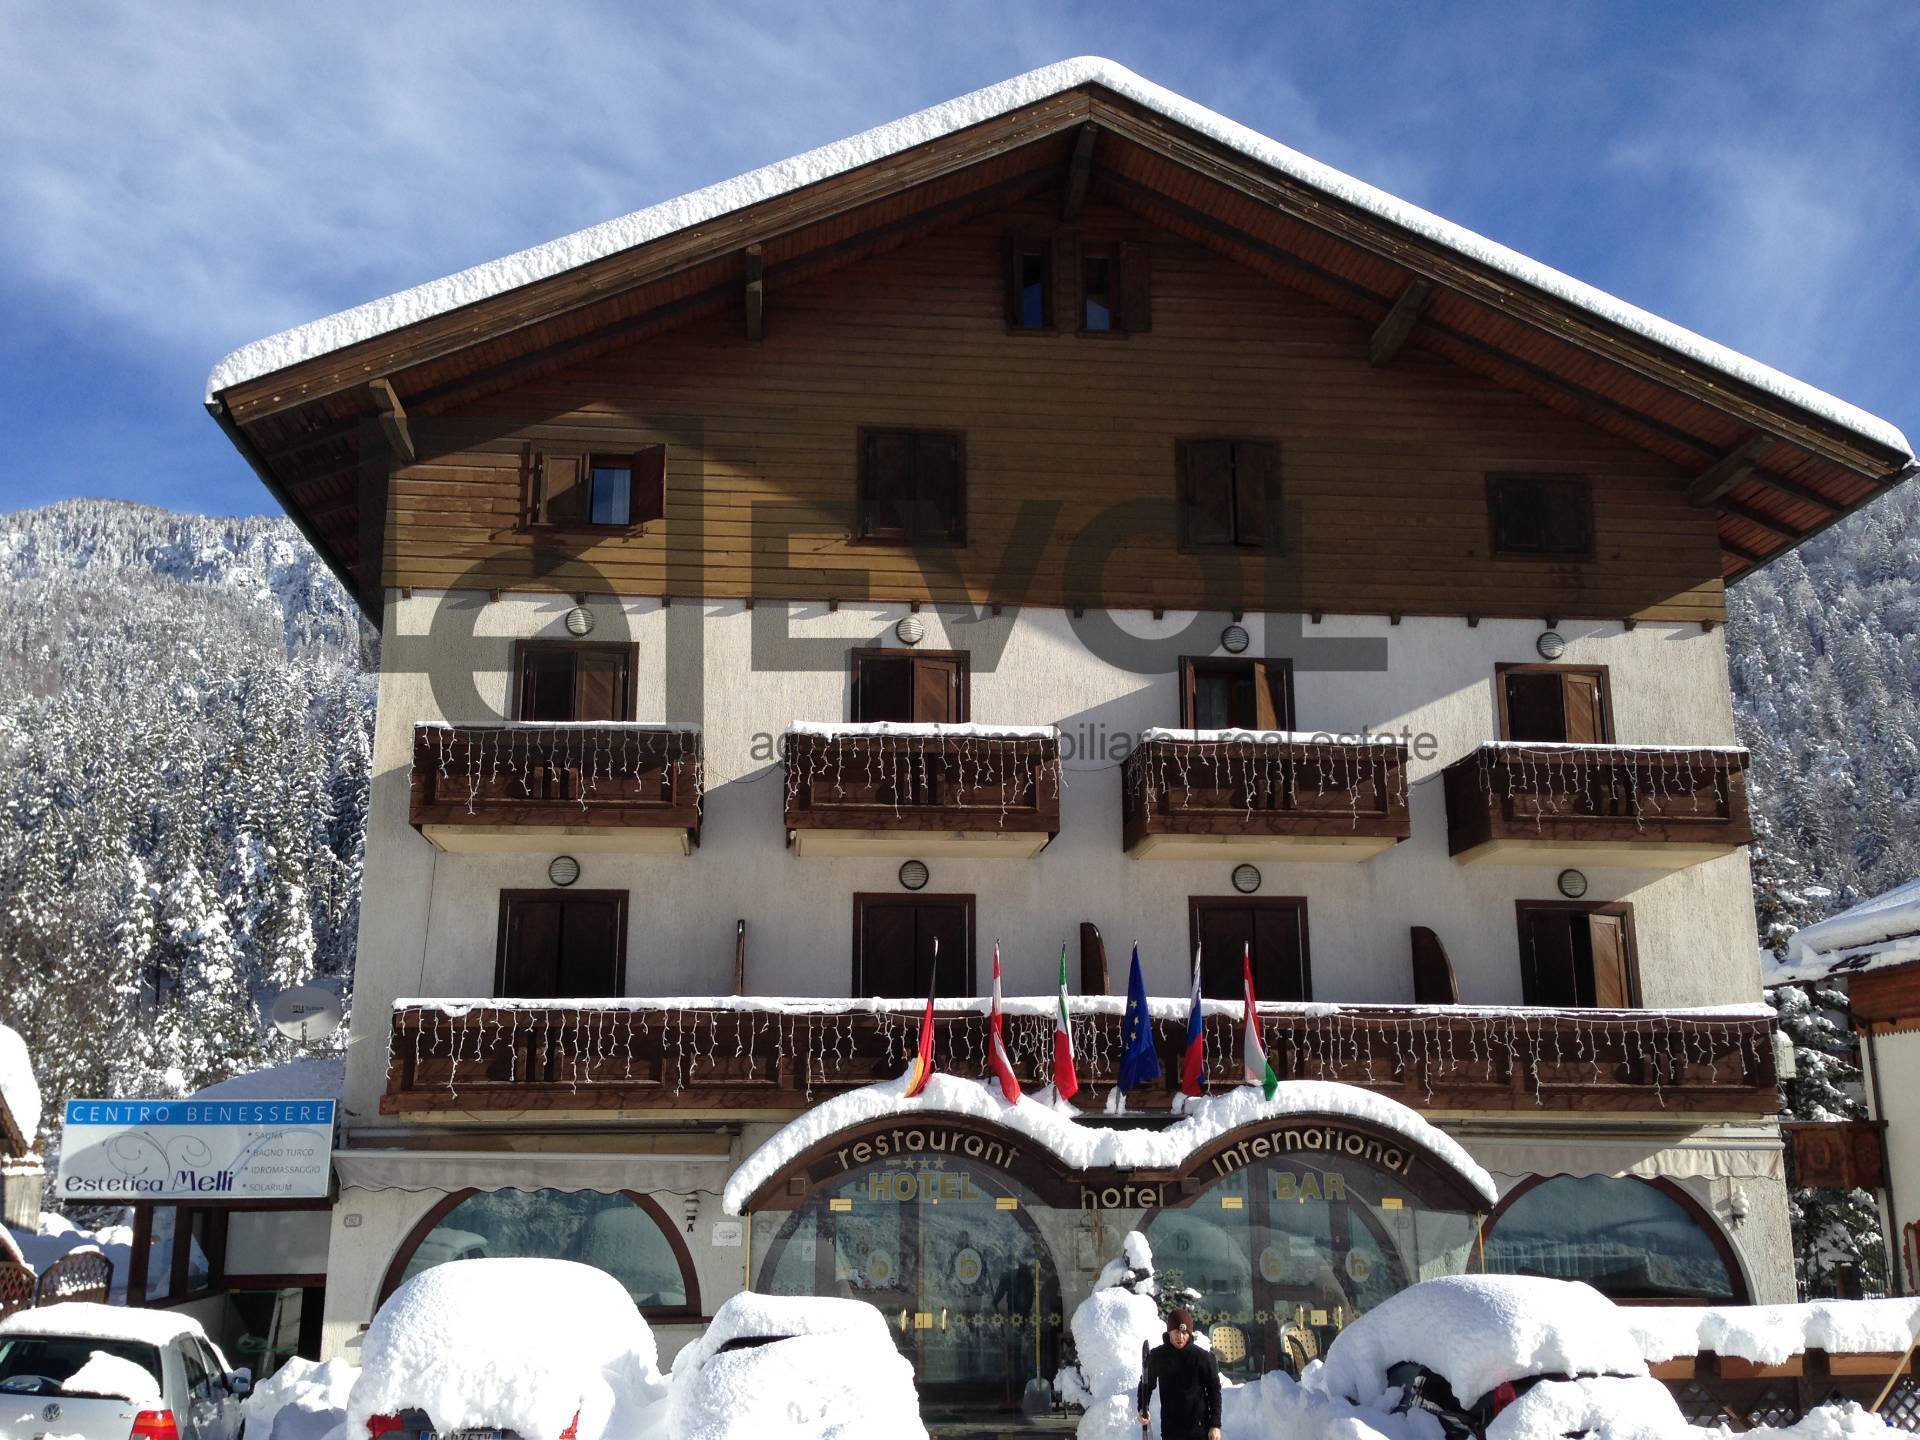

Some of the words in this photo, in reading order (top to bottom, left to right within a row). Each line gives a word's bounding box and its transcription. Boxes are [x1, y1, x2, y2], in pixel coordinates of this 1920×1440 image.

[72, 1106, 170, 1122] CENTRO
[187, 1106, 327, 1122] BENESSERE
[252, 1148, 284, 1157] BAGNO
[286, 1148, 315, 1157] TURCO
[836, 1129, 1020, 1170] restaurant
[65, 1172, 164, 1192] estetica
[172, 1170, 234, 1192] Melli
[251, 1166, 321, 1174] IDROMASSAGGIO
[249, 1183, 292, 1192] SOLARIUM
[868, 1171, 981, 1201] HOTEL
[1081, 1183, 1164, 1210] hotel
[1275, 1172, 1346, 1200] BAR
